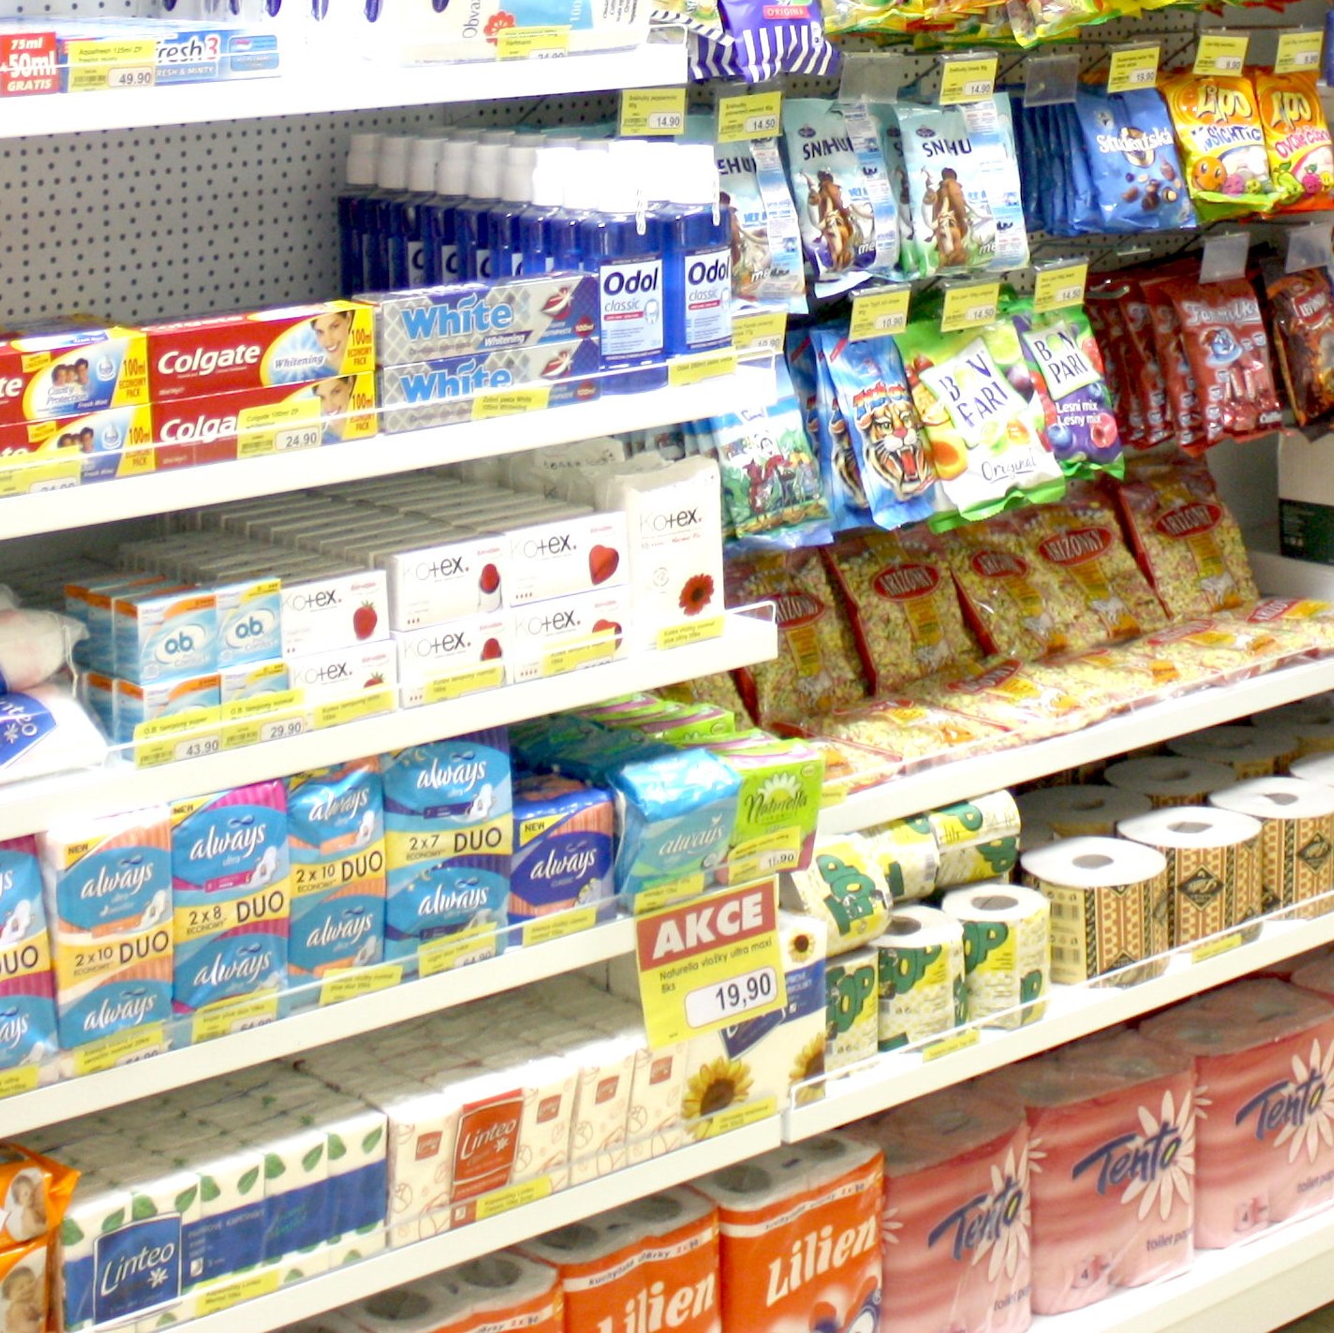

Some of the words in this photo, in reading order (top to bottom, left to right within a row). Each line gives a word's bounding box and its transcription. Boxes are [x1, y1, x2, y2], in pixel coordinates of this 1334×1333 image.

[9, 36, 45, 53] 75ml
[7, 76, 53, 94] GRATIS
[118, 69, 153, 87] 49.90
[656, 115, 681, 128] 14.90
[752, 118, 776, 131] 14.50
[603, 266, 660, 297] Odol
[687, 256, 729, 287] Odol
[399, 294, 515, 341] White
[604, 297, 641, 314] classic
[157, 342, 262, 377] Colgate
[274, 353, 327, 369] Whitening
[1051, 354, 1089, 385] PARI
[286, 432, 318, 447] 24.90
[269, 721, 302, 738] 29.90
[185, 739, 220, 757] 43.90
[415, 755, 488, 792] always
[190, 823, 266, 862] always
[453, 826, 503, 854] DUO
[529, 847, 598, 881] always
[235, 891, 285, 924] DUO
[652, 892, 763, 960] AKCE
[658, 958, 700, 982] Naturella
[701, 950, 728, 969] vložky
[750, 937, 773, 953] maxi
[715, 972, 772, 1012] 19,90
[1236, 1069, 1325, 1141] Tento
[461, 1117, 518, 1161] Linteo
[1072, 1122, 1183, 1195] Tento
[927, 1175, 1025, 1260] Tento
[100, 1243, 175, 1298] Linteo
[766, 1215, 878, 1308] Lilien
